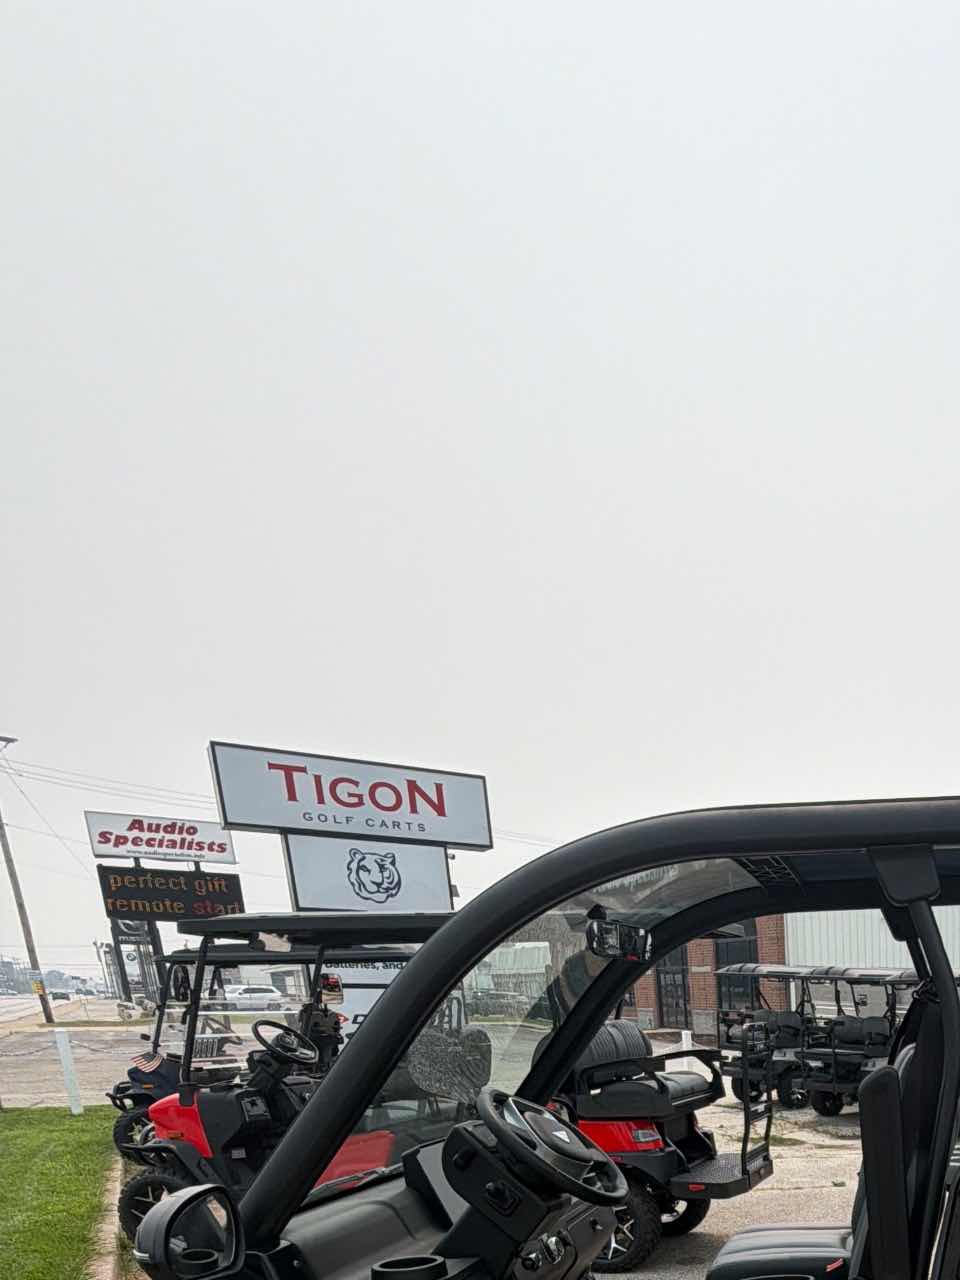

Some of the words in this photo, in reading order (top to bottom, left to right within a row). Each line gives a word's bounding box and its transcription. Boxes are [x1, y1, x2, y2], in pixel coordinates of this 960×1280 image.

[267, 761, 448, 818] TIGON
[127, 818, 199, 836] Audio
[303, 812, 355, 825] GOLF
[365, 818, 427, 832] CARTS
[97, 831, 228, 853] Specialists
[109, 872, 187, 891] perfect
[194, 876, 228, 896] gift
[107, 898, 185, 914] remote
[192, 900, 241, 915] start
